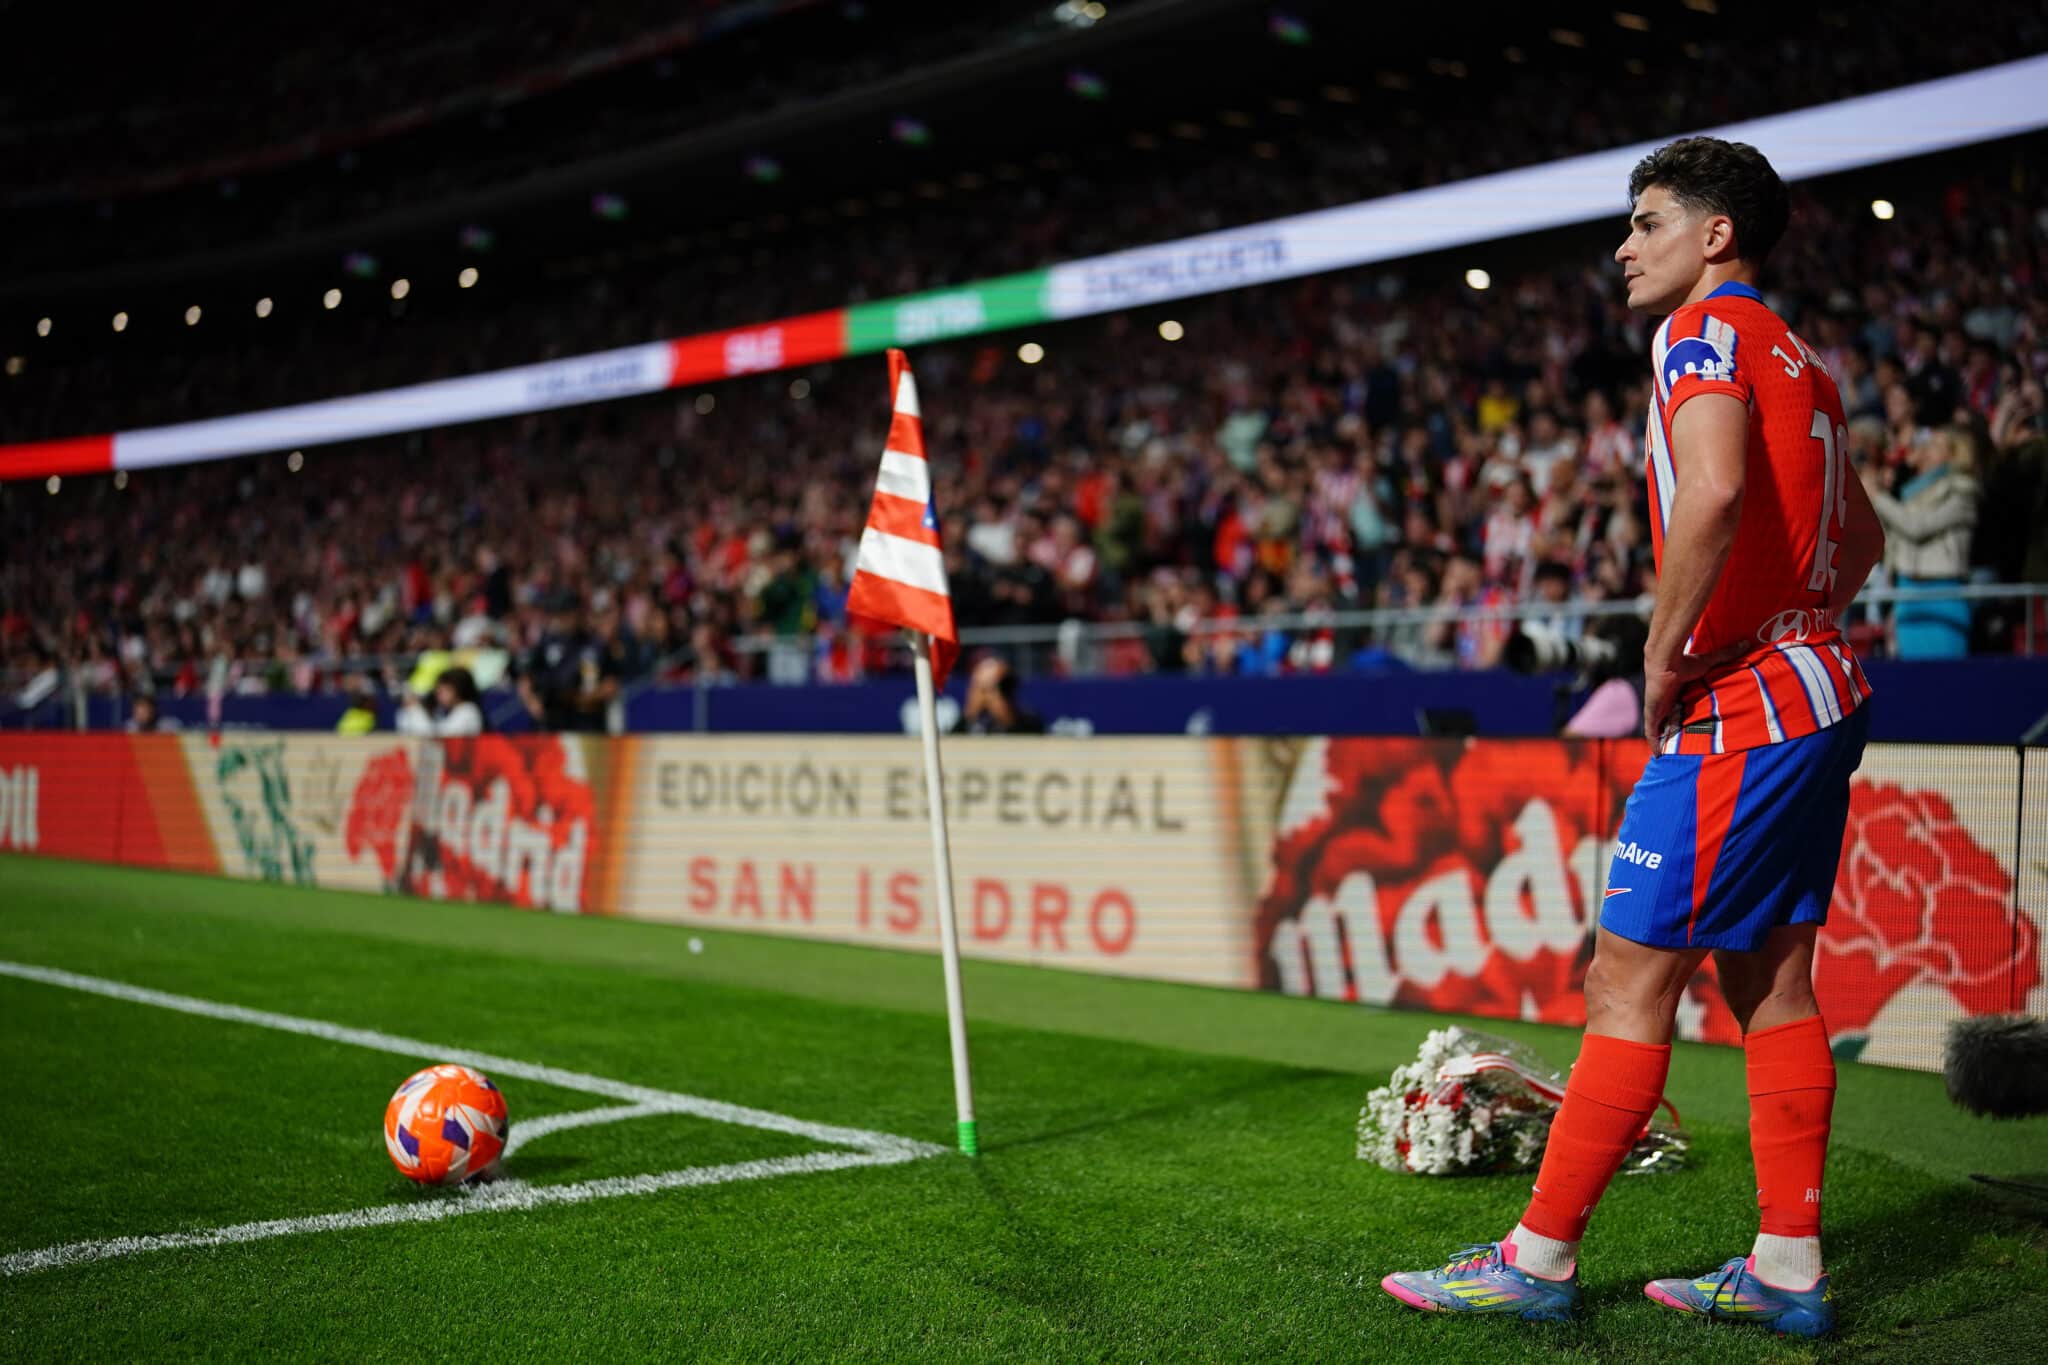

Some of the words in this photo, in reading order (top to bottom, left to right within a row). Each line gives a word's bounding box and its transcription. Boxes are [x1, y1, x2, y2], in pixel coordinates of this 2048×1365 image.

[657, 754, 861, 819] EDICIÓN
[687, 856, 815, 923] SAN
[856, 866, 1138, 957] ISDRO
